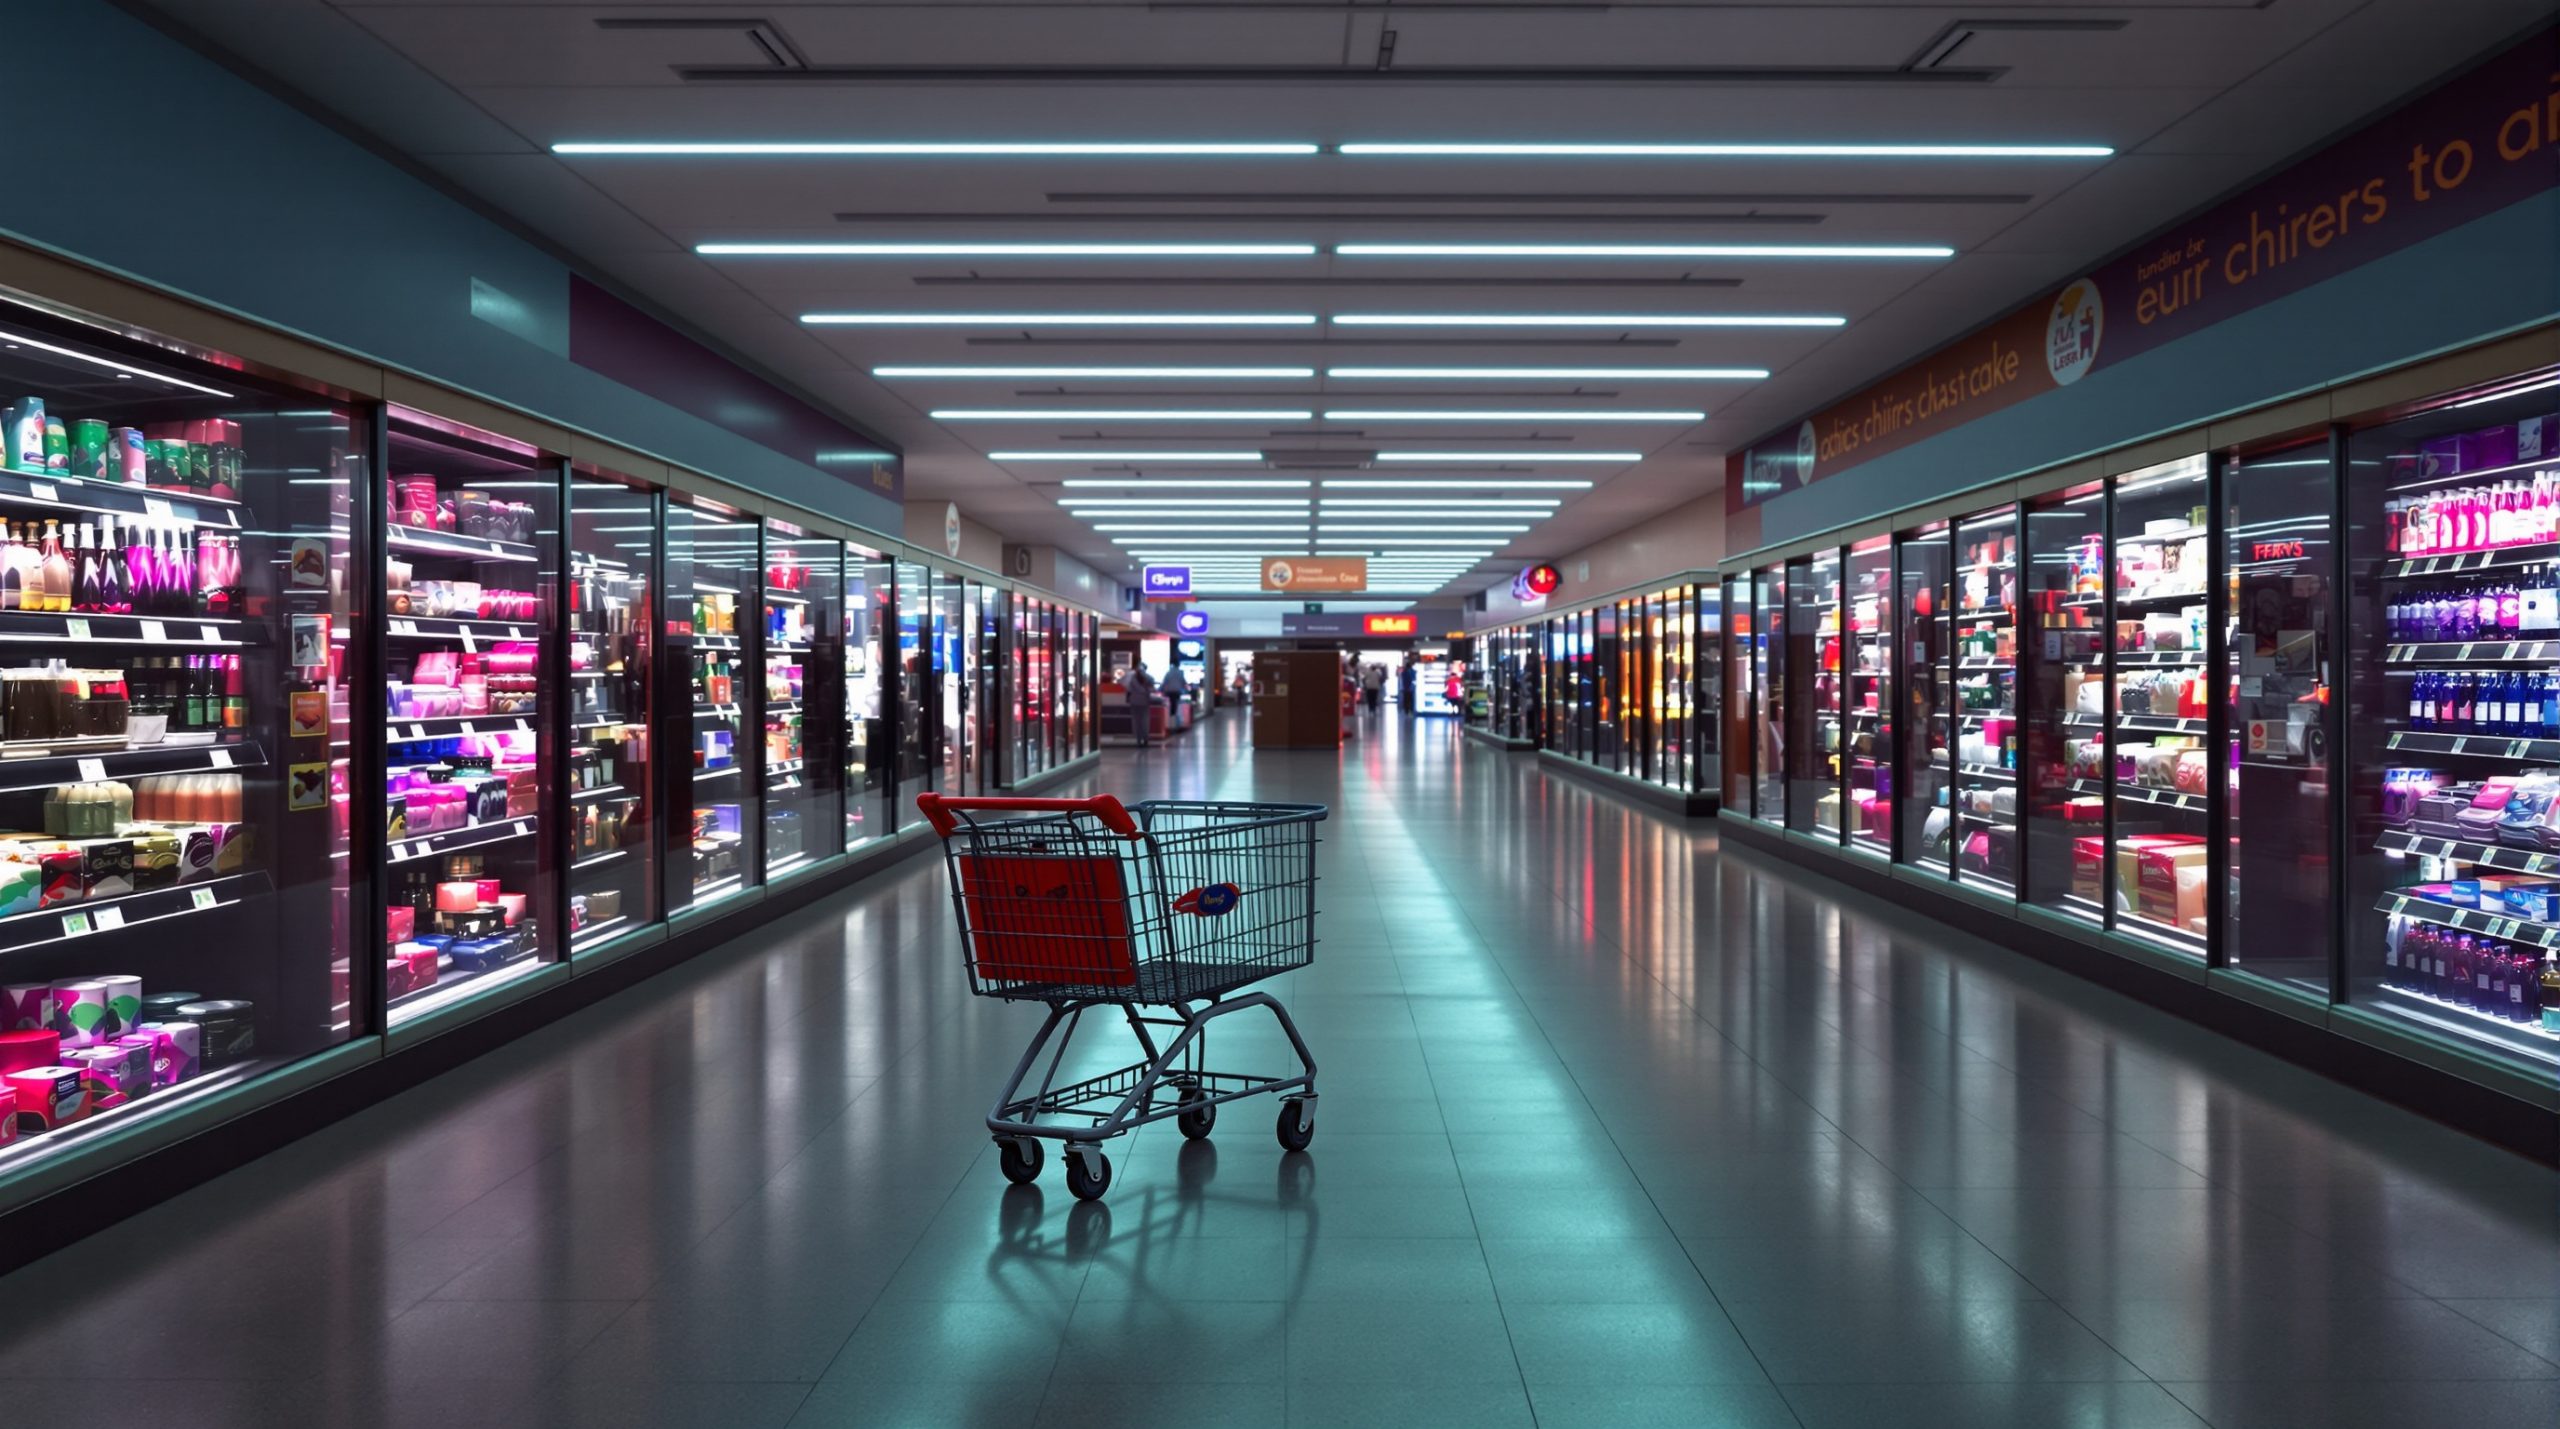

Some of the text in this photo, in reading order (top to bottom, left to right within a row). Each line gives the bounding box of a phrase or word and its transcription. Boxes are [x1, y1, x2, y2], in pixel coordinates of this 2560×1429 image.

[2224, 178, 2387, 285] chirers
[2408, 139, 2472, 201] to
[1918, 371, 1966, 419] chast
[1969, 340, 2019, 397] cake
